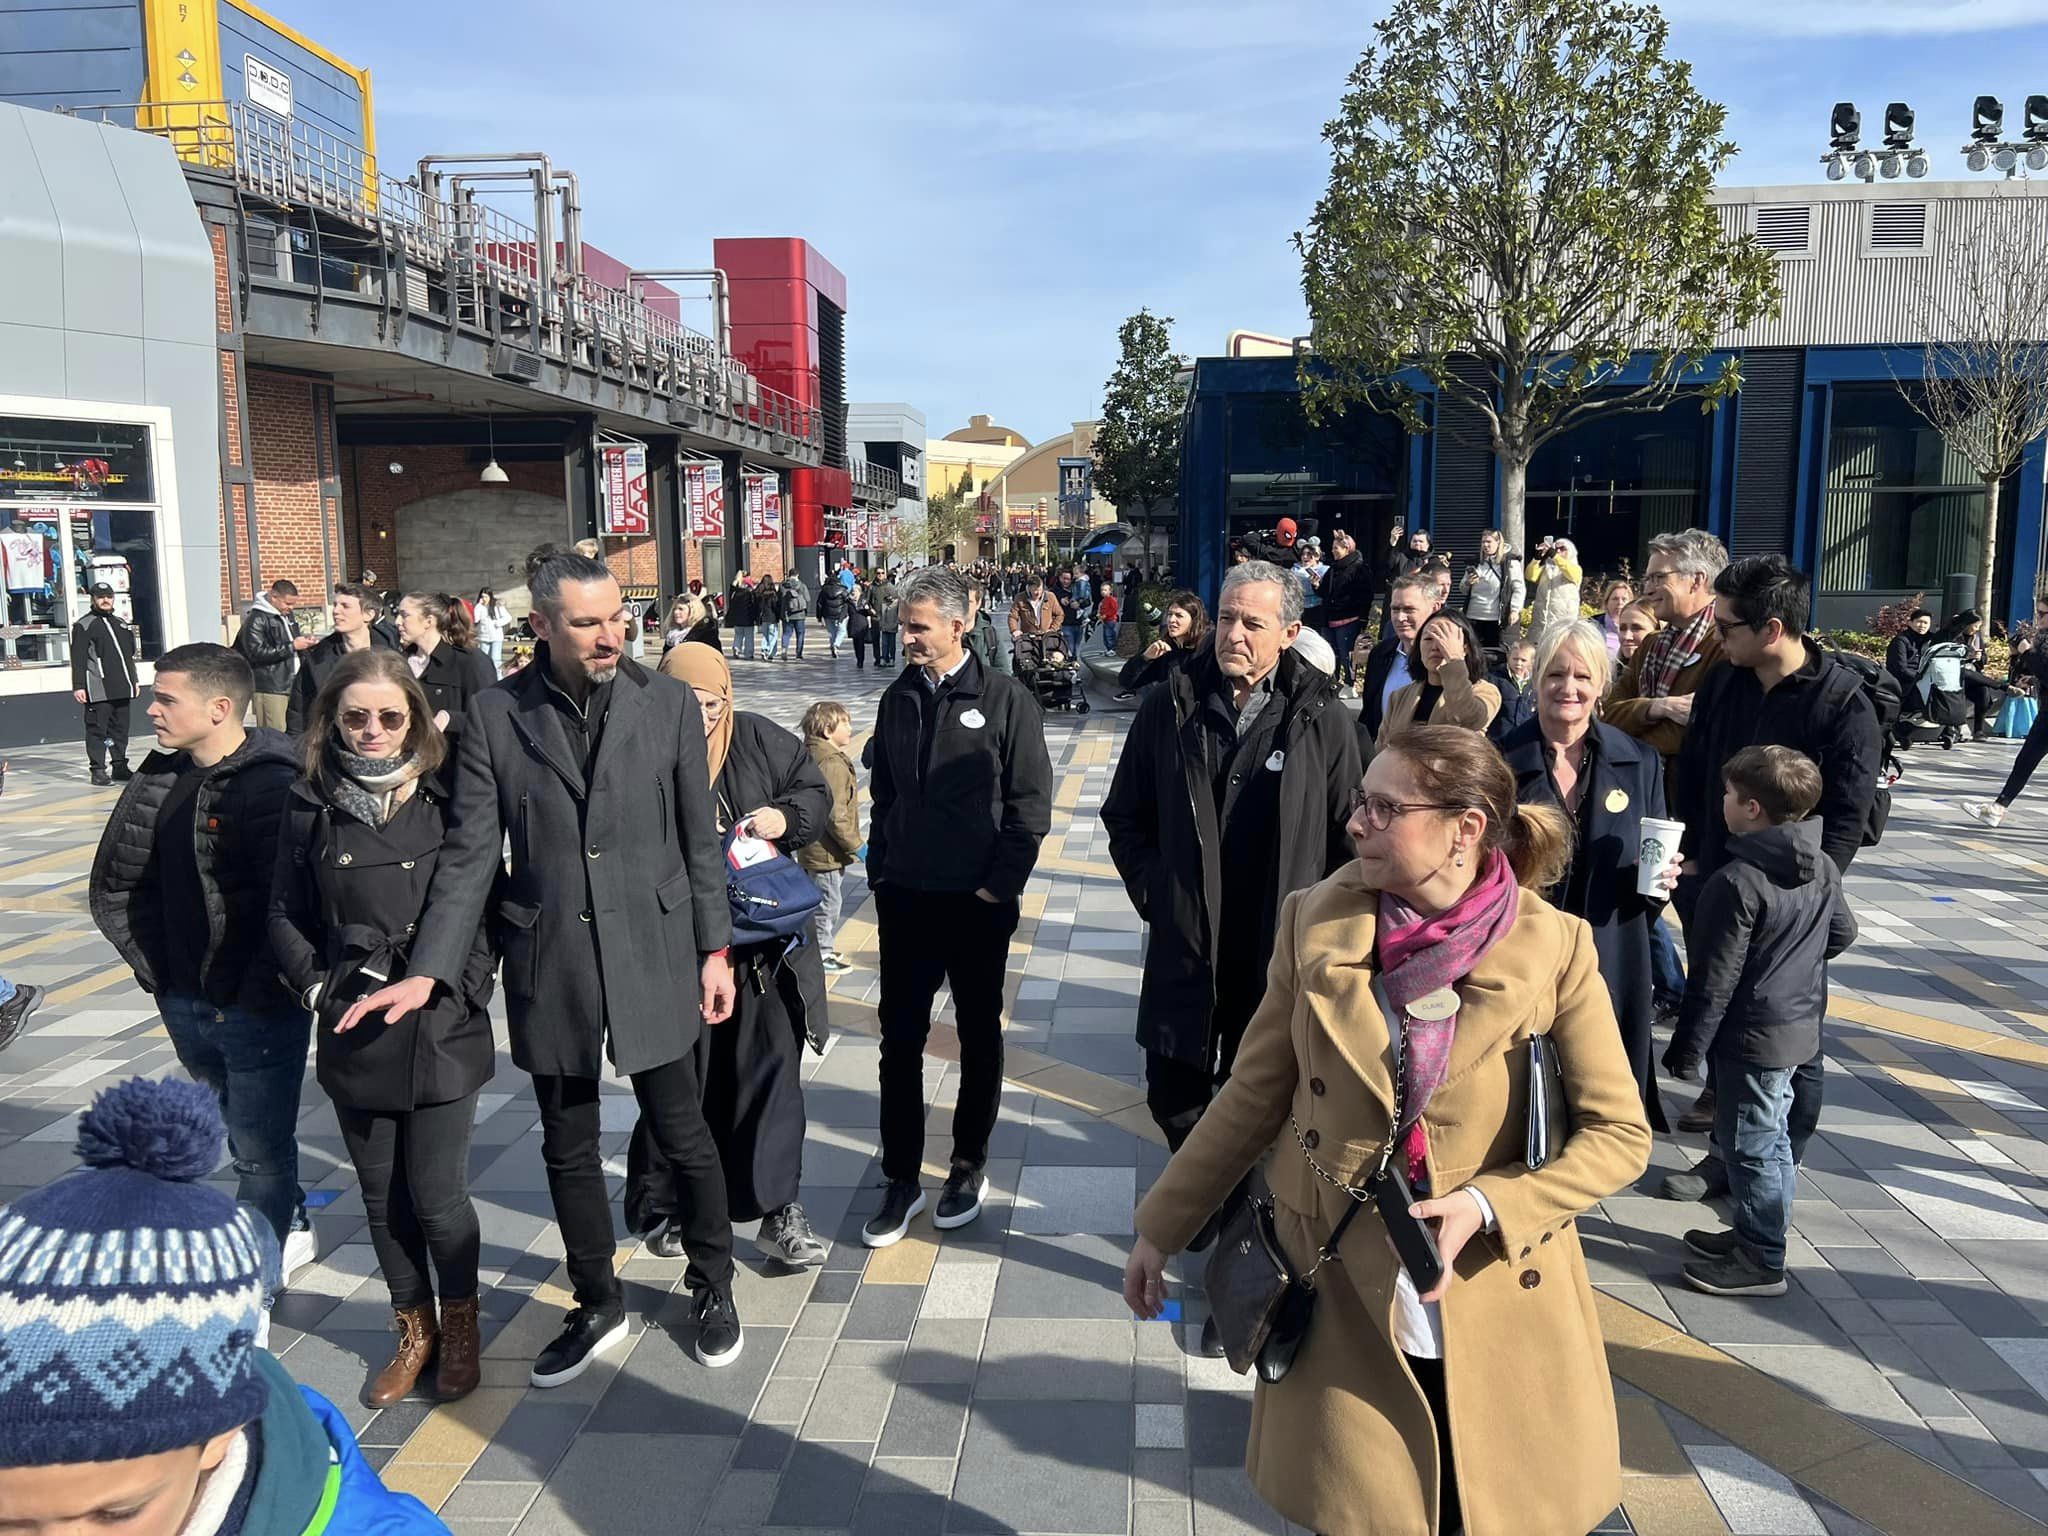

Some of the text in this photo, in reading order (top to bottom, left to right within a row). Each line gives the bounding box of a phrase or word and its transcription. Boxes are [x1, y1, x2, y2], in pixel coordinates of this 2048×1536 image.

[610, 453, 625, 527] PORTES OUVERTES
[691, 468, 705, 531] OPEN HOUSE
[751, 480, 763, 536] OPEN HOUSE
